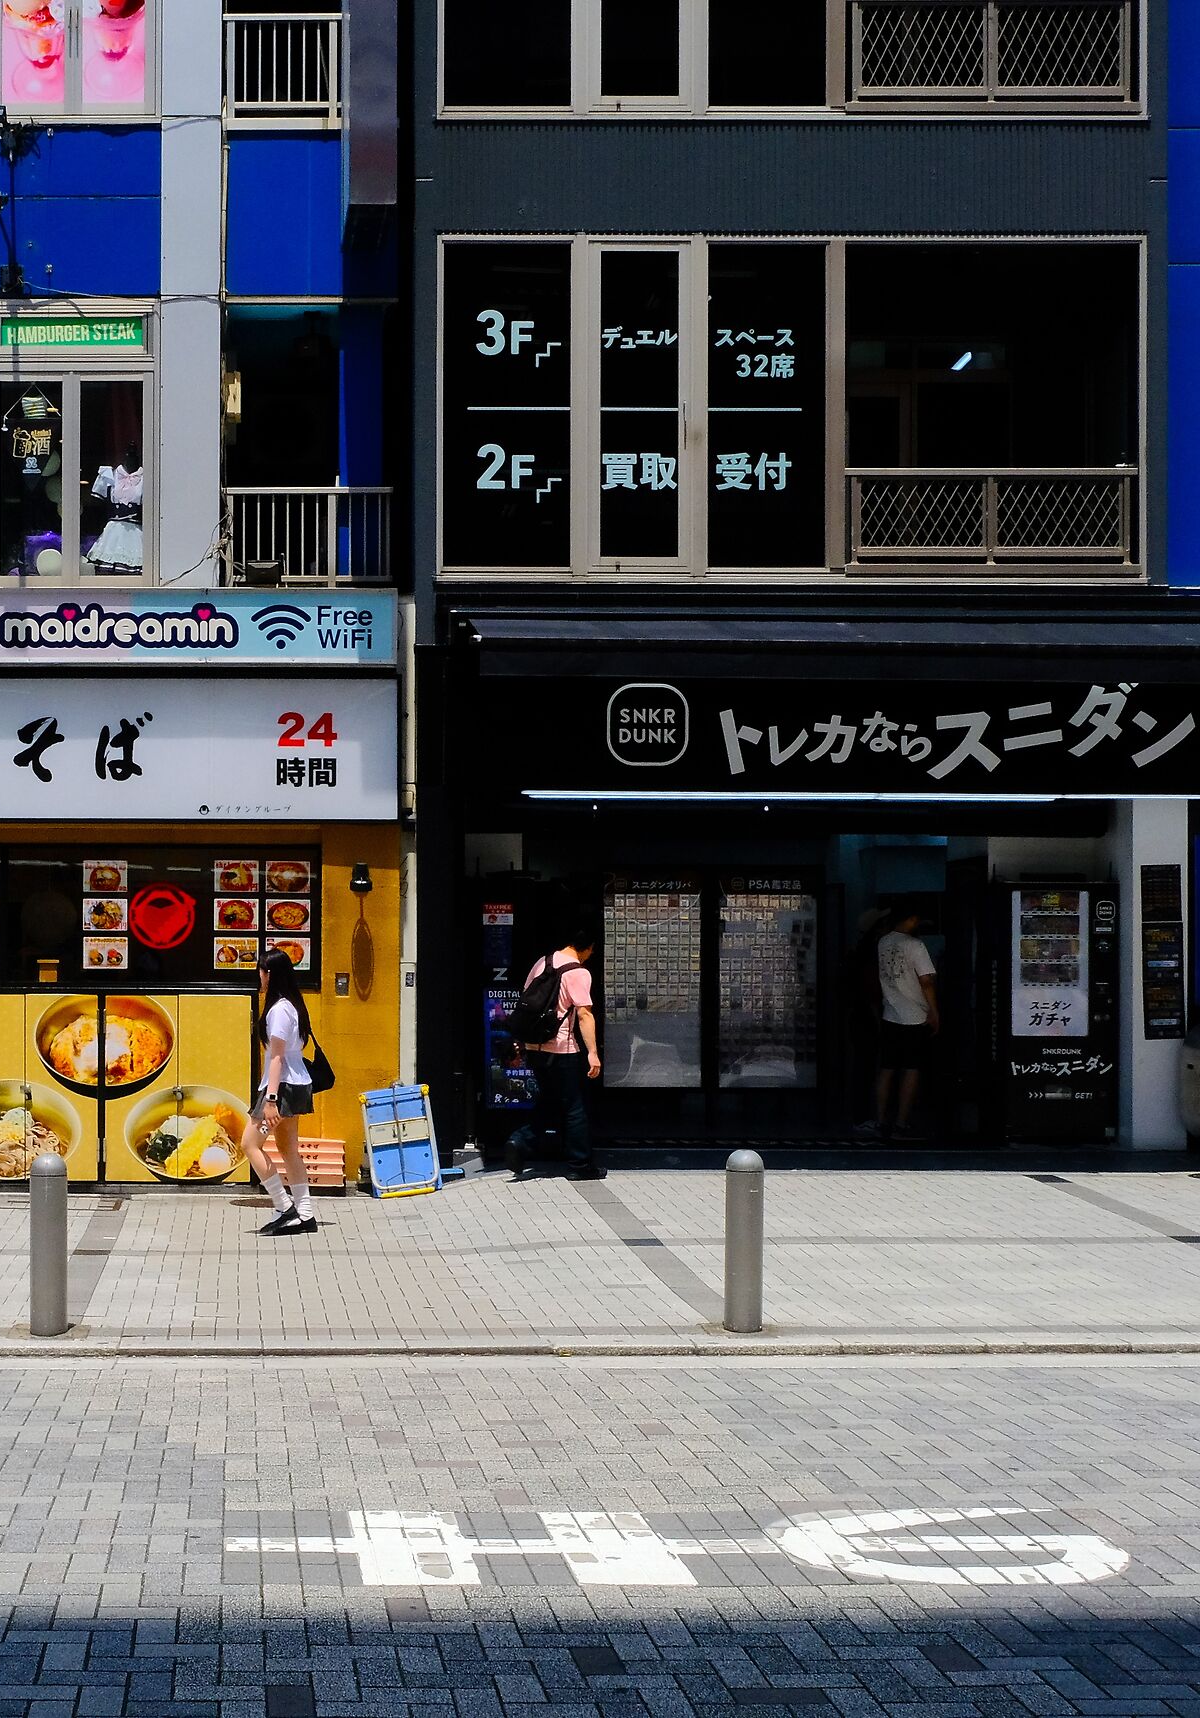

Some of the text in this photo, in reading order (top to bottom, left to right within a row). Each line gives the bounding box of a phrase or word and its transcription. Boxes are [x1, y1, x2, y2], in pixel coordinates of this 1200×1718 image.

[6, 322, 136, 346] HAMBURGER STEAK
[475, 309, 795, 356] 3F デュエル スペース
[735, 354, 795, 379] 32席
[475, 443, 792, 491] 2F 買取 受付
[3, 606, 236, 644] maidreamin
[317, 605, 373, 626] Free
[317, 629, 373, 650] WiFi
[619, 708, 676, 724] SNKR
[277, 711, 338, 747] 24
[618, 728, 676, 744] DUNK
[719, 683, 1196, 780] トレカならスニダン
[276, 757, 337, 788] 時間
[1030, 1000, 1072, 1010] スニダン
[1028, 1012, 1072, 1027] ガチャ
[1010, 1054, 1113, 1077] トレカならスニダン
